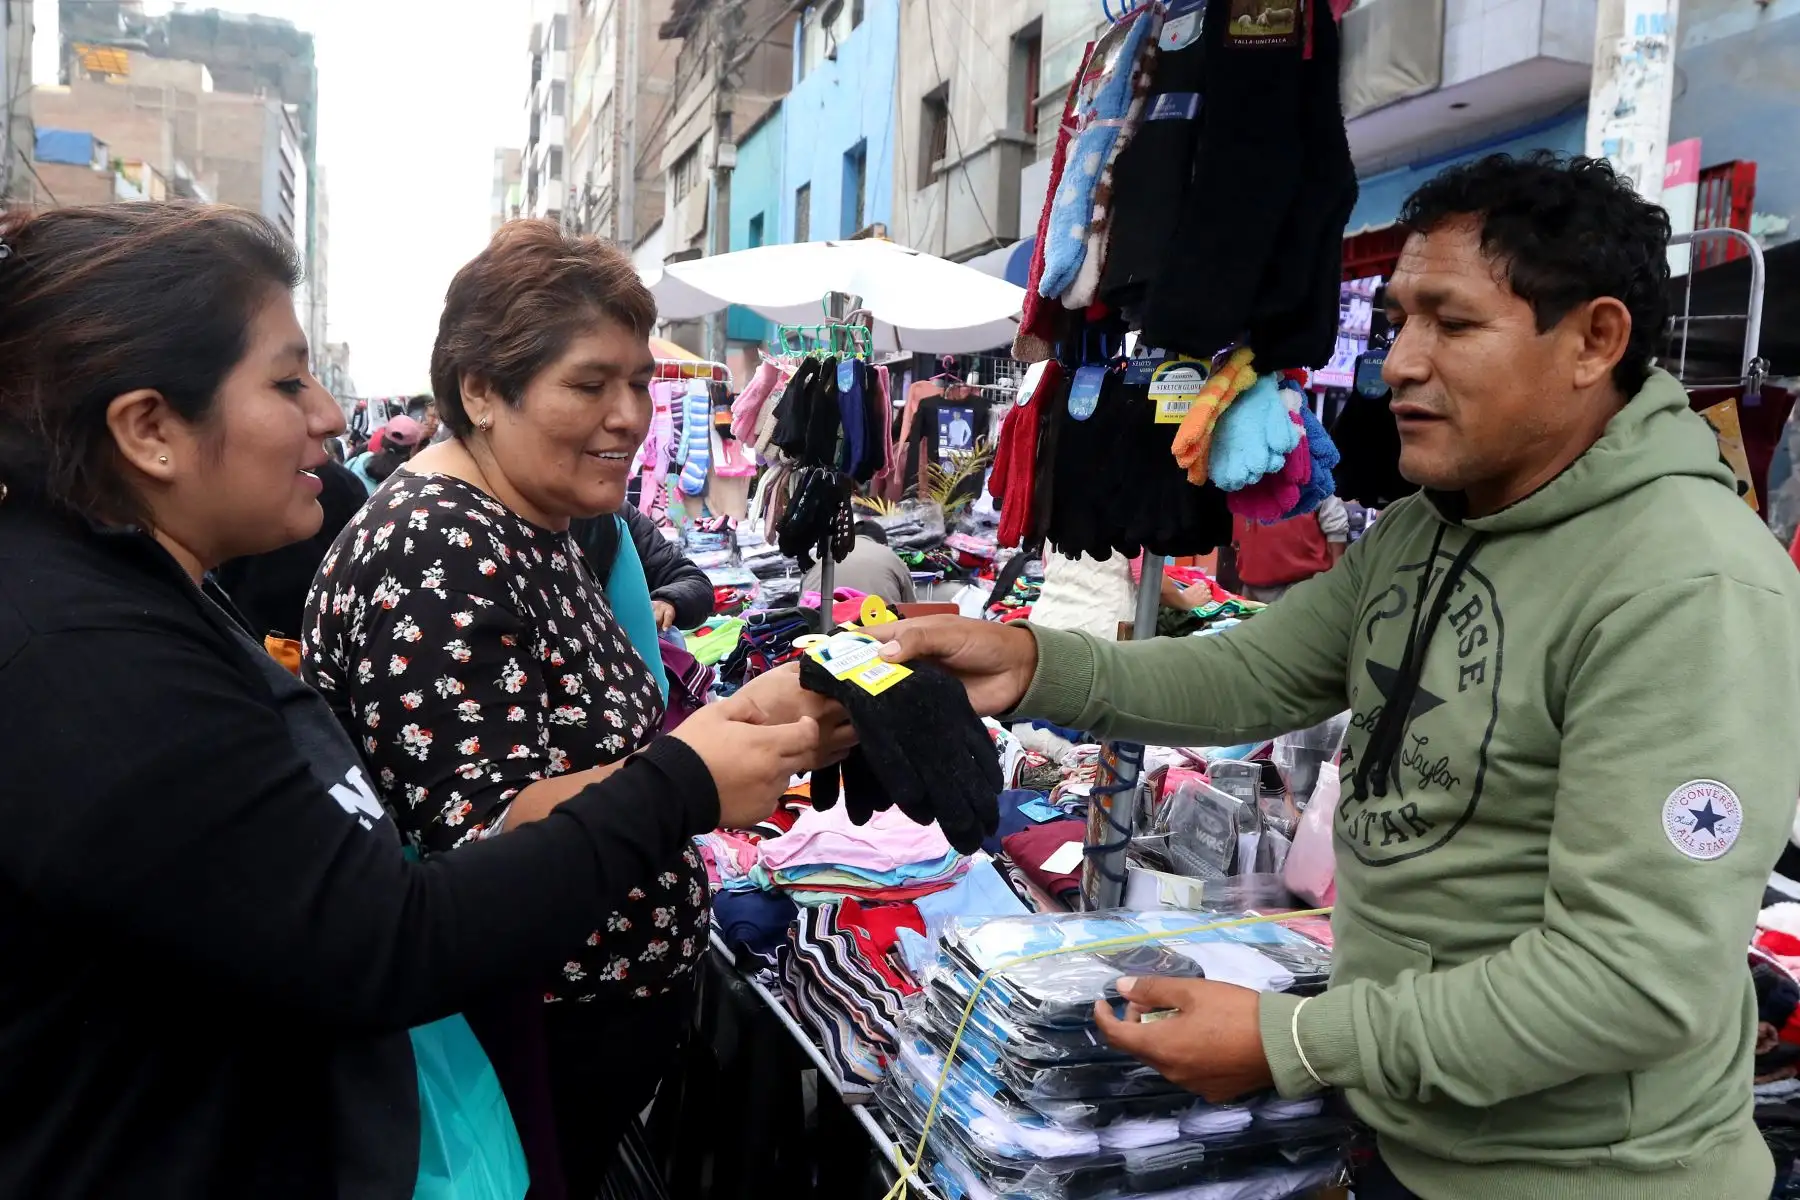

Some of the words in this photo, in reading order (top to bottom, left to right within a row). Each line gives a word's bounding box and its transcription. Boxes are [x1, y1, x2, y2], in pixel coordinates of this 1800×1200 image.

[1402, 733, 1461, 791] Taylor
[1680, 789, 1734, 815] CONVERSE
[1677, 829, 1695, 847] ALL
[1699, 838, 1725, 851] STAR
